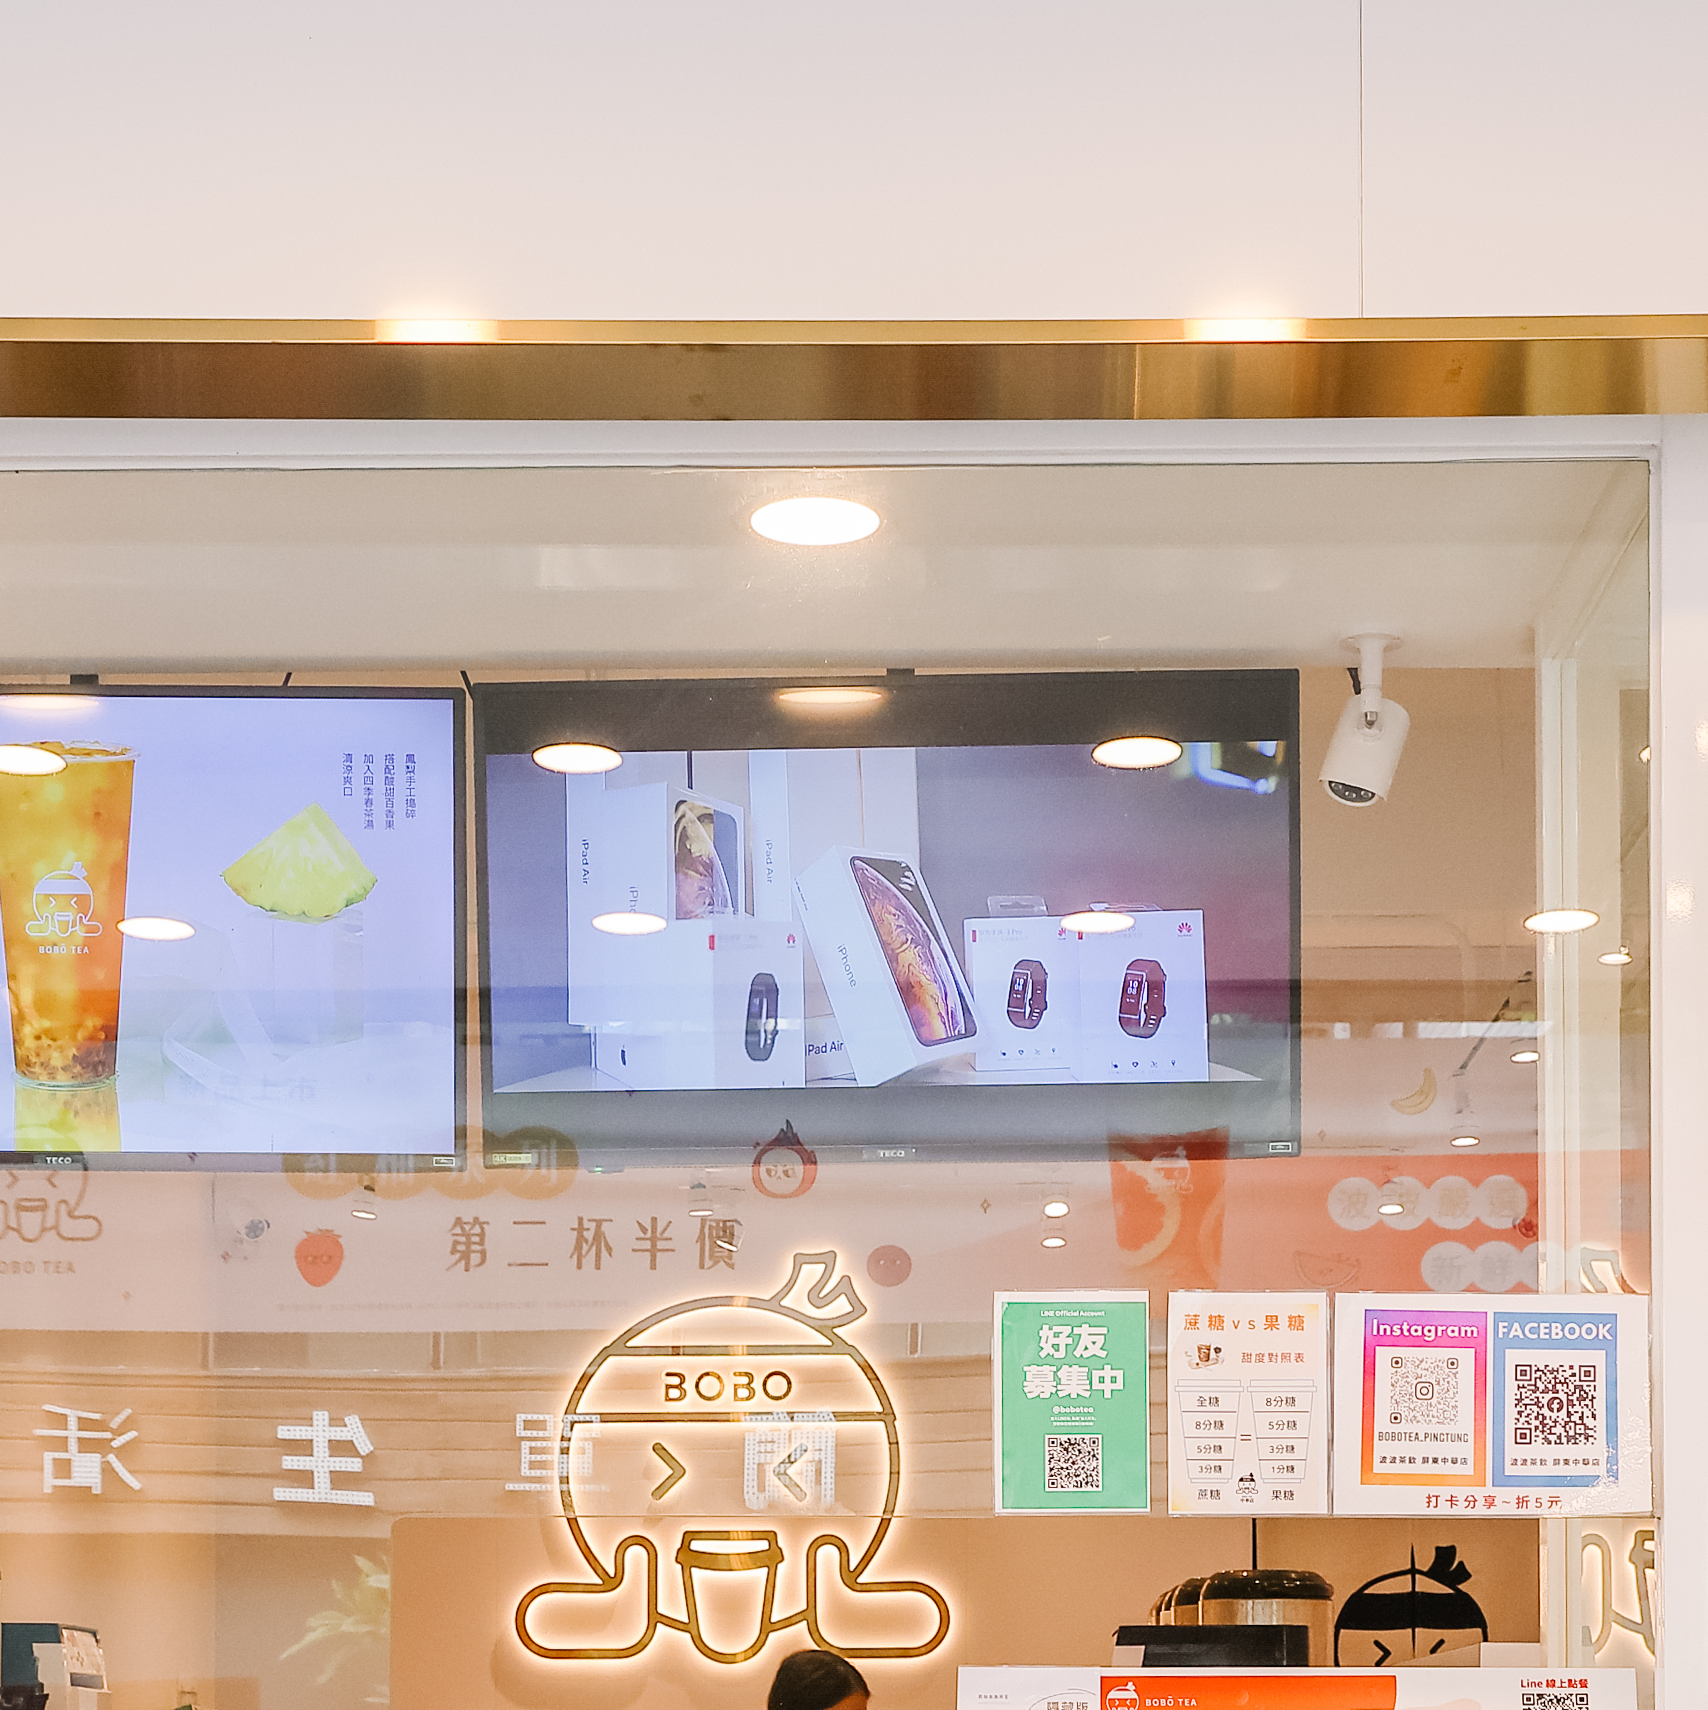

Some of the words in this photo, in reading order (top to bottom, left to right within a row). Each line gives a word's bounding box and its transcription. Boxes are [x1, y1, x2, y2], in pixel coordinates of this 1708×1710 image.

[363, 753, 374, 830] 加入四季春茶湯
[581, 838, 589, 865] iPad
[765, 839, 773, 865] iPad
[69, 945, 90, 955] TEA
[837, 943, 857, 988] iPhone
[829, 1041, 844, 1052] Air
[45, 1156, 72, 1165] TECO
[445, 1215, 744, 1273] 第二杯半價
[1371, 1318, 1479, 1342] Instagram
[1497, 1320, 1613, 1341] FACEBOOK
[1038, 1323, 1109, 1359] 好友
[1241, 1352, 1305, 1364] 甜度對照表
[663, 1370, 793, 1402] BOBO
[1023, 1364, 1124, 1399] 募集中
[1196, 1395, 1220, 1408] 全糖
[1265, 1395, 1296, 1408] 8分糖
[1052, 1405, 1094, 1413] @bobotea
[1195, 1419, 1224, 1431] 8分糖
[1268, 1419, 1297, 1431] 5分糖
[1196, 1444, 1223, 1454] 5分糖
[1269, 1444, 1295, 1454] 3分糖
[1378, 1455, 1417, 1465] 波波茶飲
[1421, 1456, 1469, 1466] 屏東中華店
[1509, 1457, 1548, 1467] 波波茶飲
[1552, 1458, 1601, 1467] 屏東中華店
[1198, 1464, 1223, 1474] 3分糖
[1271, 1464, 1295, 1474] 1分糖
[1197, 1488, 1221, 1501] 蔗糖
[1271, 1489, 1295, 1501] 果糖
[1520, 1679, 1543, 1688] Line
[1545, 1678, 1589, 1689] 線上點餐
[1178, 1698, 1197, 1707] TEA
